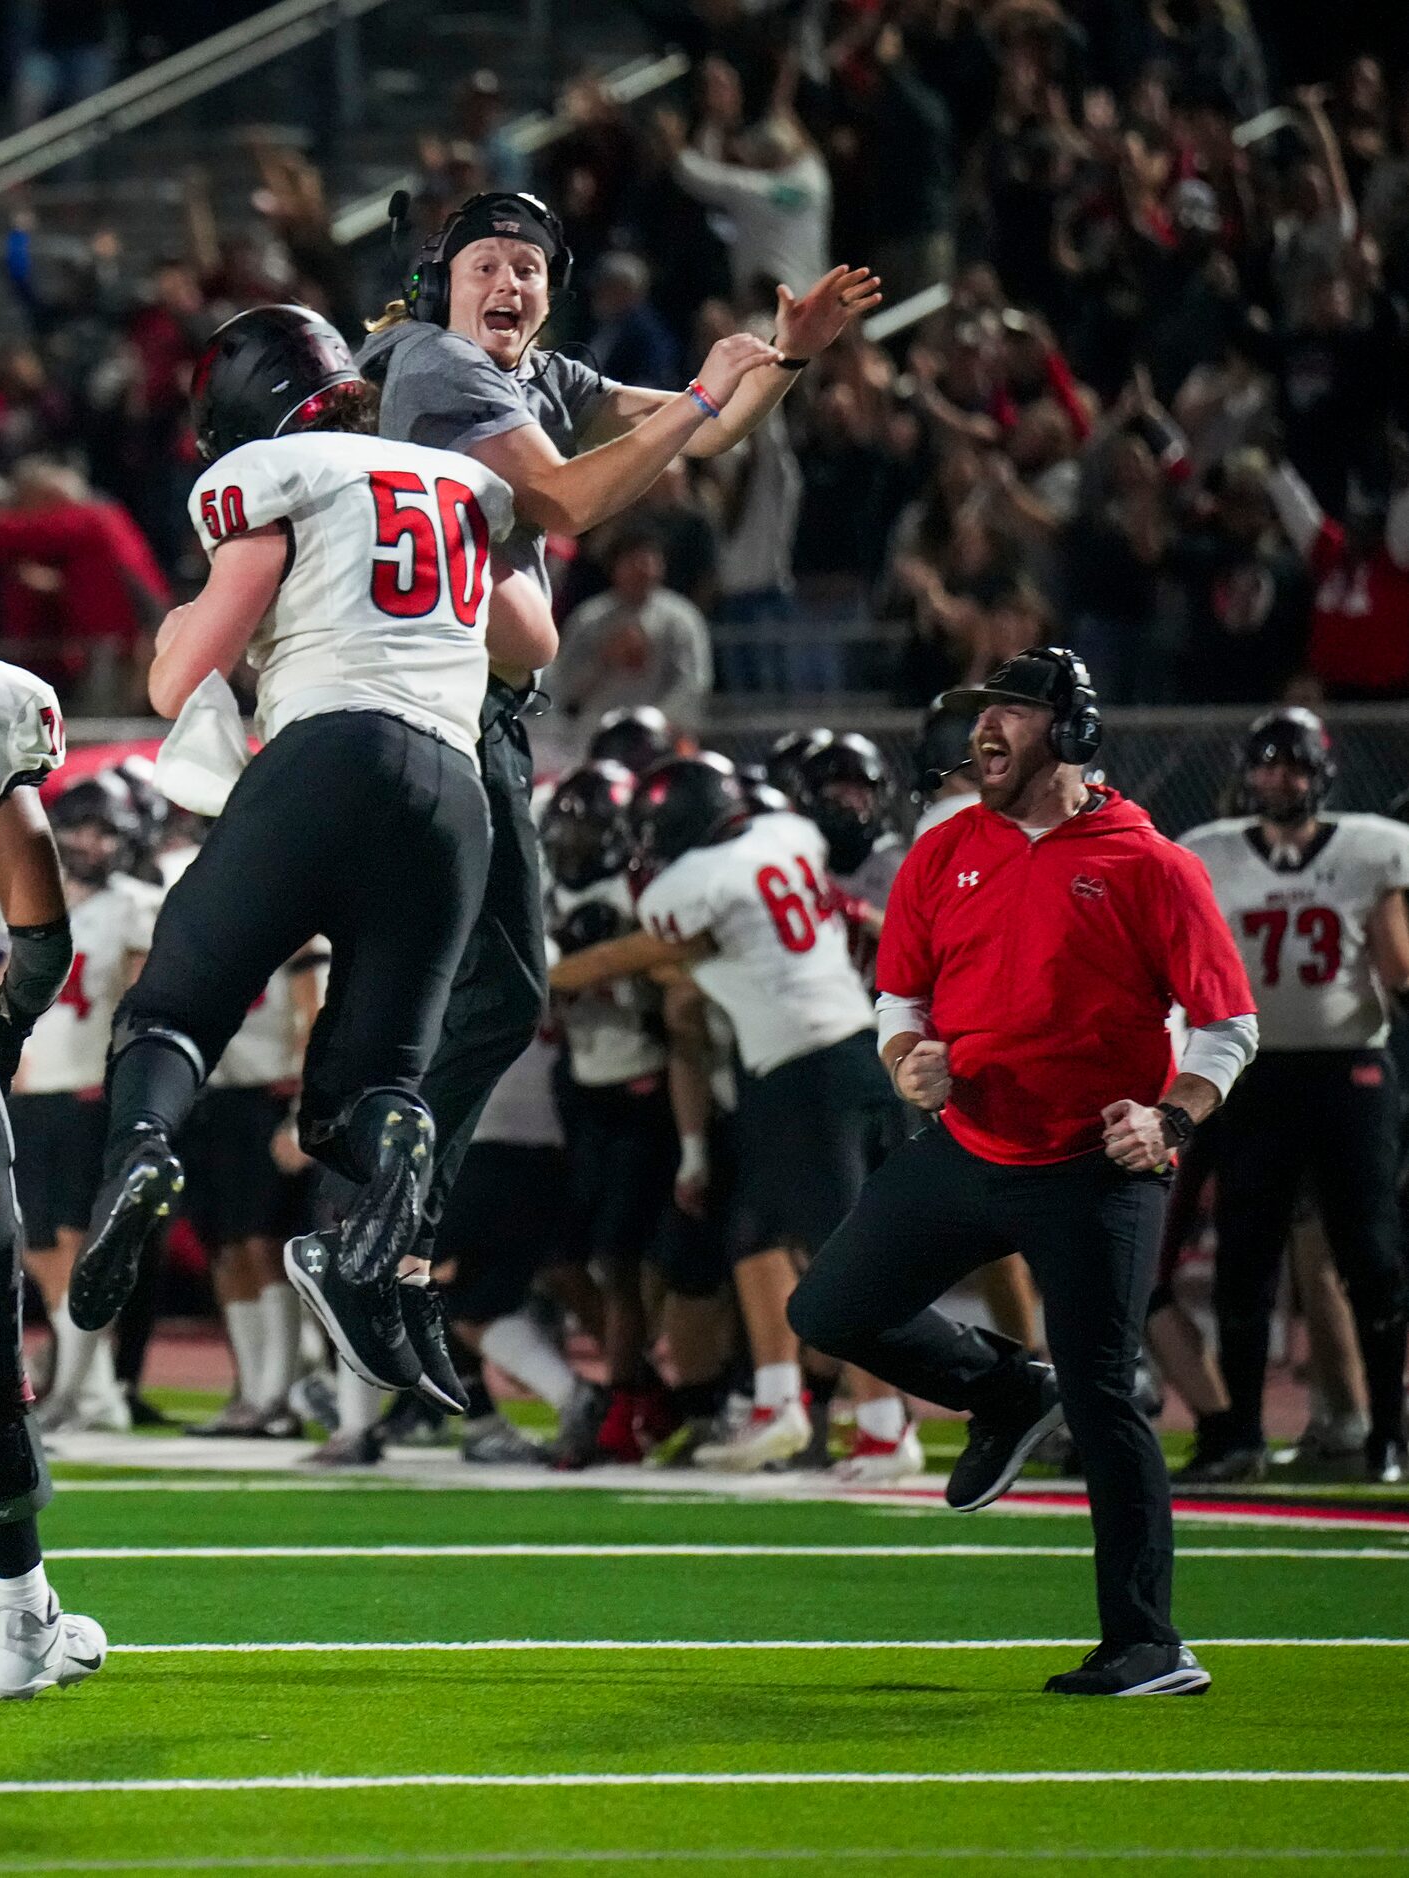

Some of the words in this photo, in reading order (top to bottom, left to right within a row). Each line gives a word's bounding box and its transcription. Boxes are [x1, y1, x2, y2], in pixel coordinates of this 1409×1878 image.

[200, 485, 248, 540] 50
[365, 471, 489, 627] 50
[1241, 907, 1341, 986] 73
